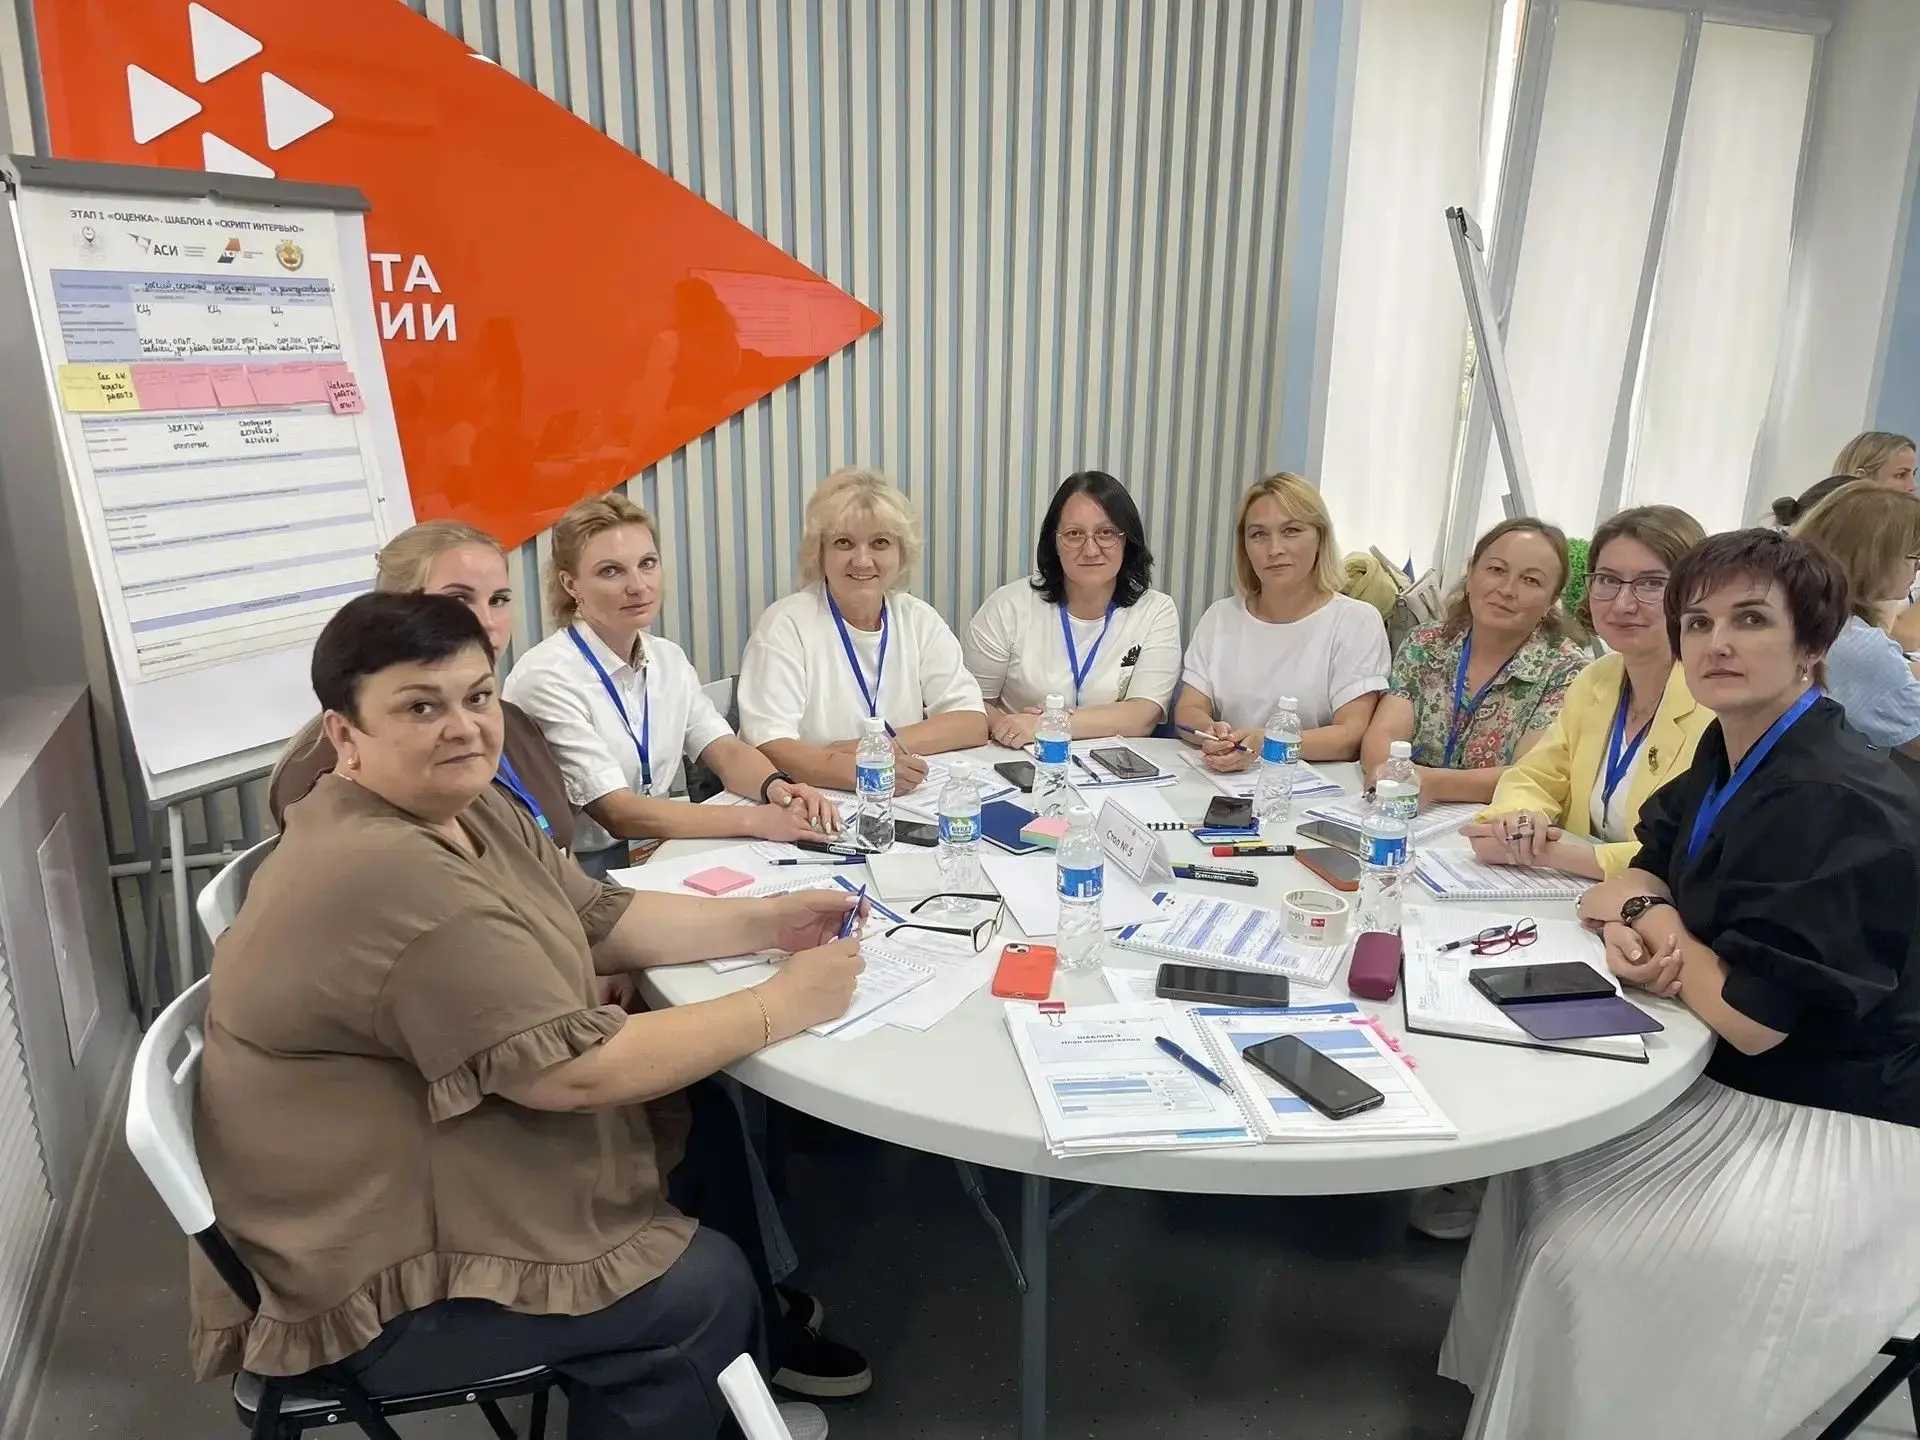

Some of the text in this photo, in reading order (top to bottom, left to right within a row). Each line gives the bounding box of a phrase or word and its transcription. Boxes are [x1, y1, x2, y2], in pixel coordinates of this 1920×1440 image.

[70, 210, 305, 233] ЭТАП 1 «ОЦЕНКА». ШАБЛОН 4 «СКРИПТ ИНТЕРВЬЮ»
[154, 244, 179, 256] АСИ
[370, 253, 442, 294] ТА
[380, 301, 457, 342] ИИ
[1106, 830, 1121, 848] Стол
